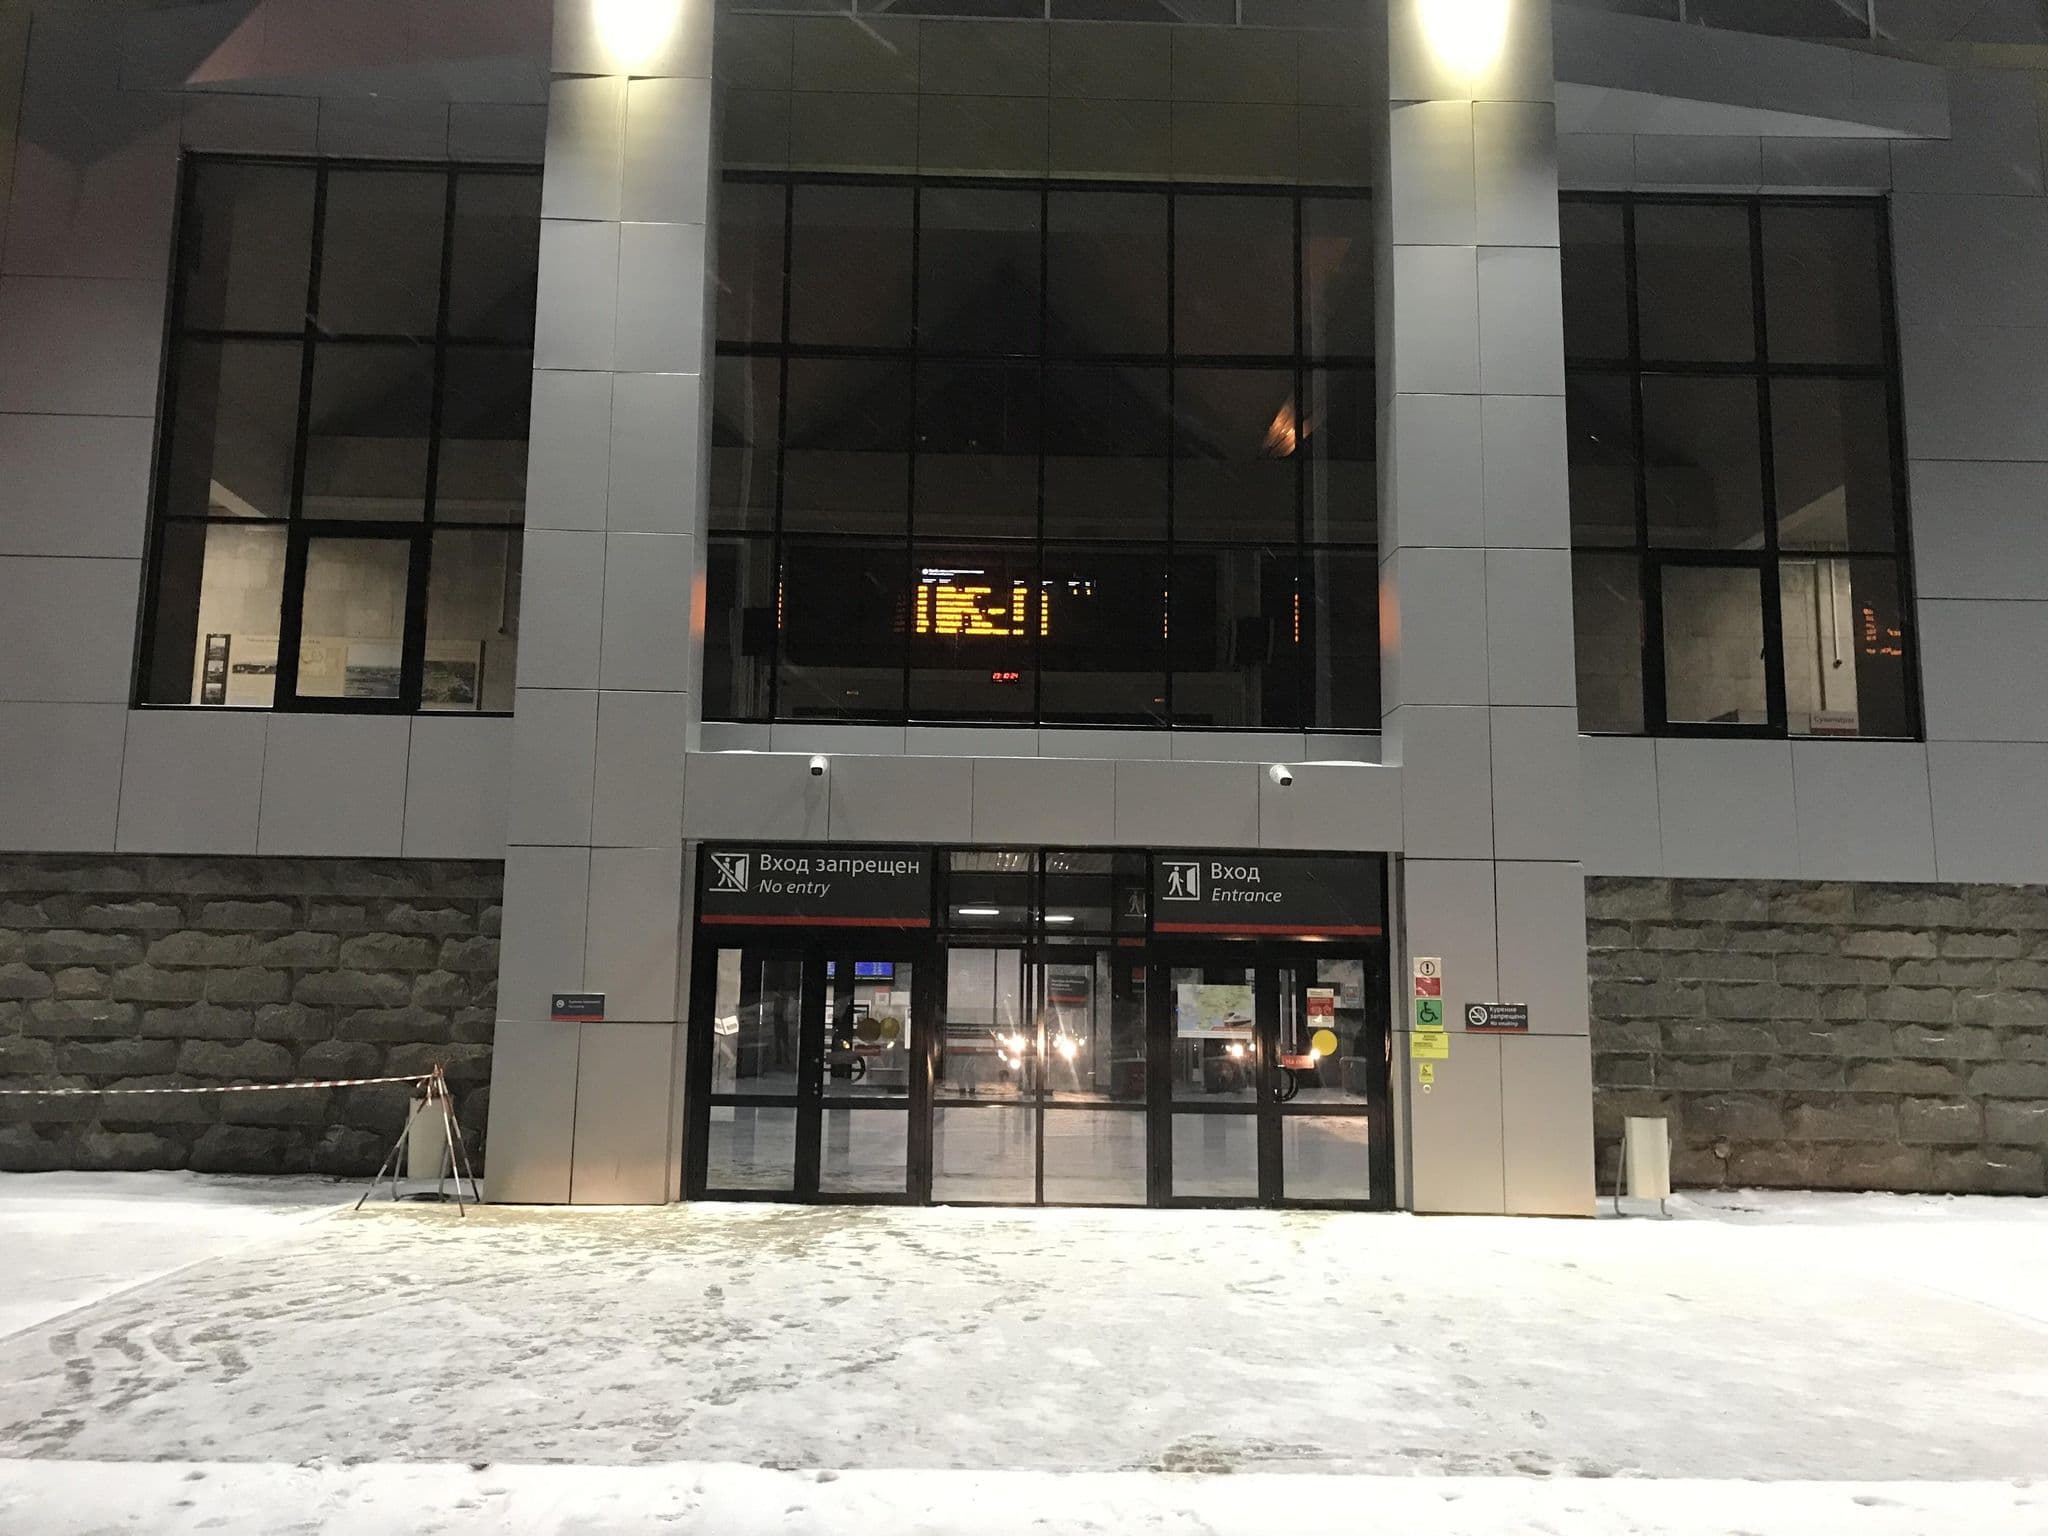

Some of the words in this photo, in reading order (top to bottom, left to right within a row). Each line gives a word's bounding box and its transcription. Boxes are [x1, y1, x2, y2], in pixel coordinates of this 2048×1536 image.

[760, 853, 810, 875] Вход
[816, 857, 920, 877] запрещен
[1210, 862, 1261, 883] Вход
[759, 879, 782, 893] No
[786, 880, 830, 897] entry
[1211, 887, 1282, 903] Entrance
[1489, 1006, 1518, 1014] Курение
